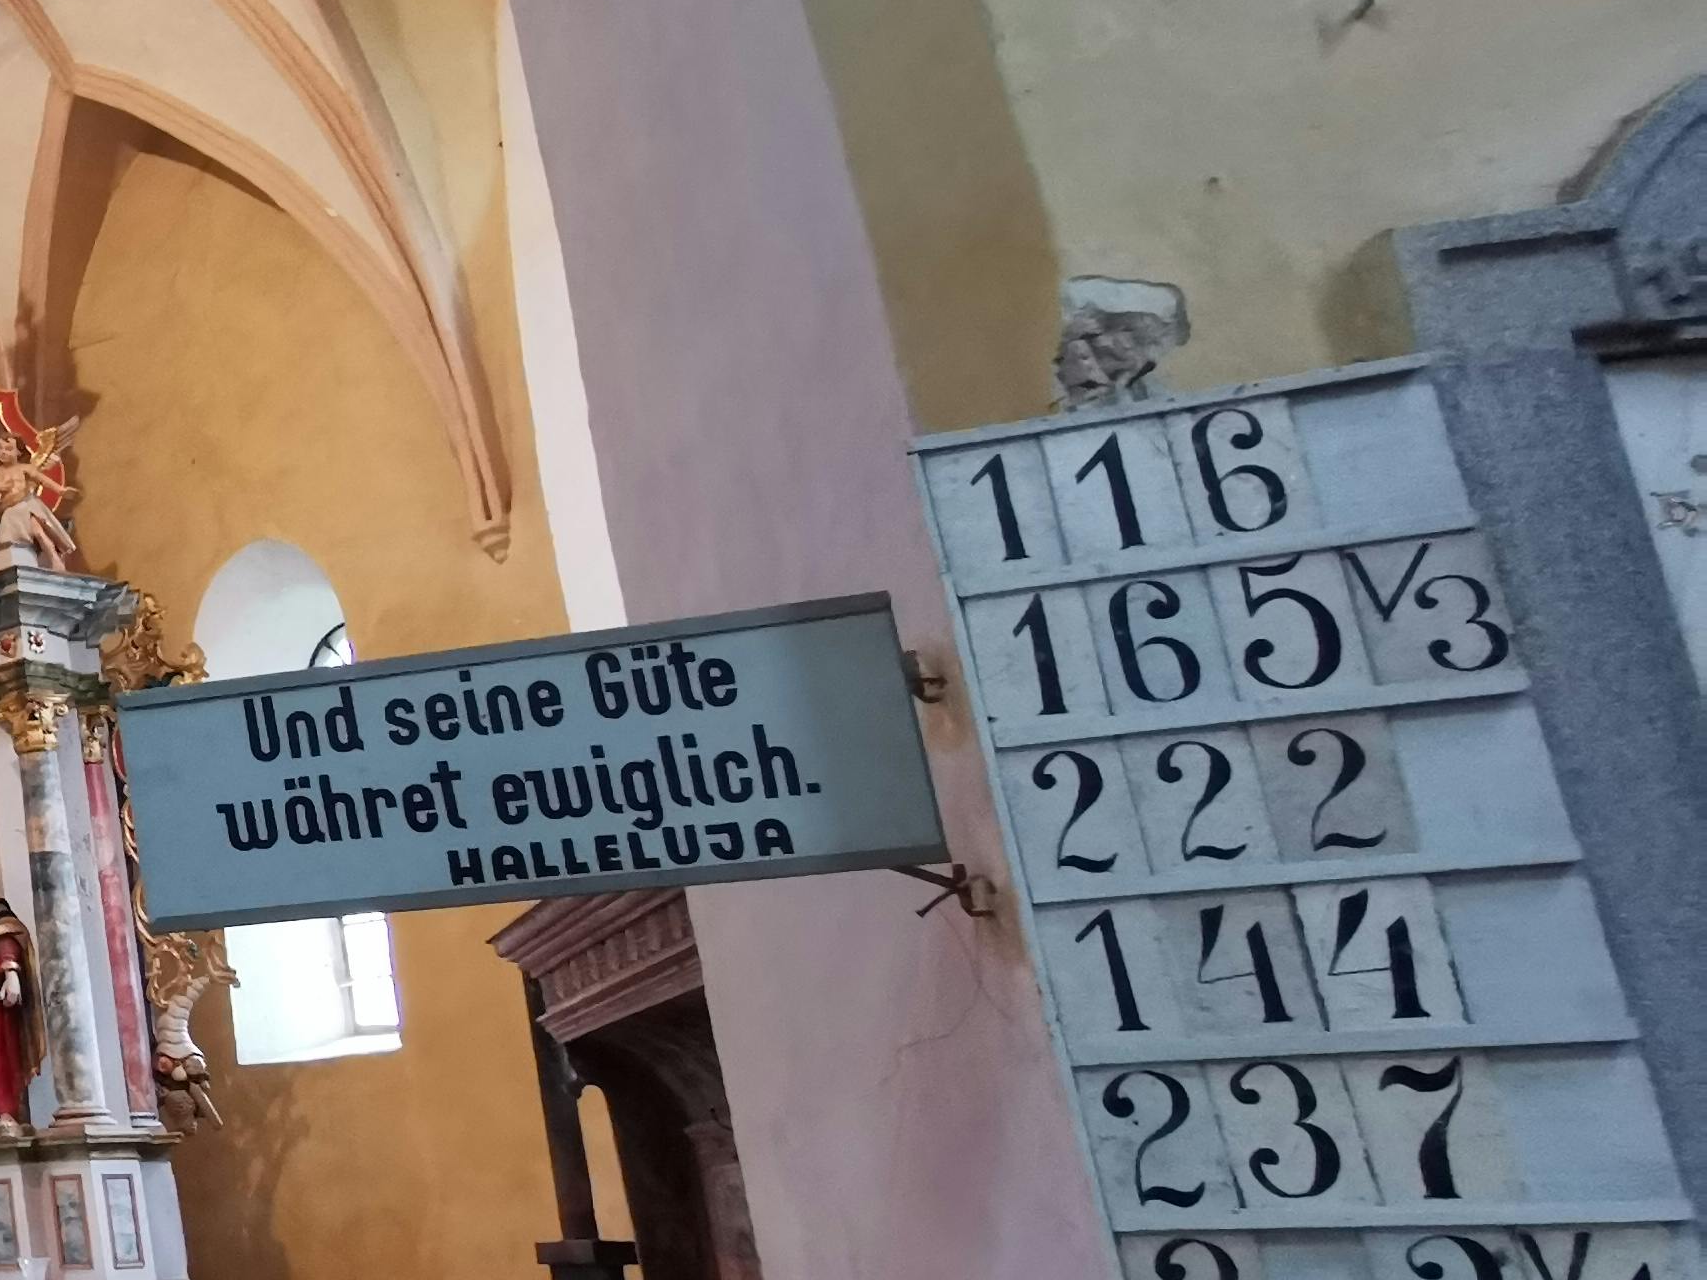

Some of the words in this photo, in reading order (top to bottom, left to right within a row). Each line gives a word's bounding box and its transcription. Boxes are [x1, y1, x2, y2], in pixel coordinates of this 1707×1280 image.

[970, 408, 1288, 562] 116
[243, 686, 364, 762] Und
[384, 670, 564, 746] seine
[585, 641, 739, 719] Güte
[216, 760, 469, 853] währet
[492, 724, 823, 832] ewiglich.
[445, 817, 796, 887] HALLELUJA
[1033, 728, 1388, 873] 222
[1073, 888, 1431, 1032] 144
[1101, 1054, 1464, 1209] 237
